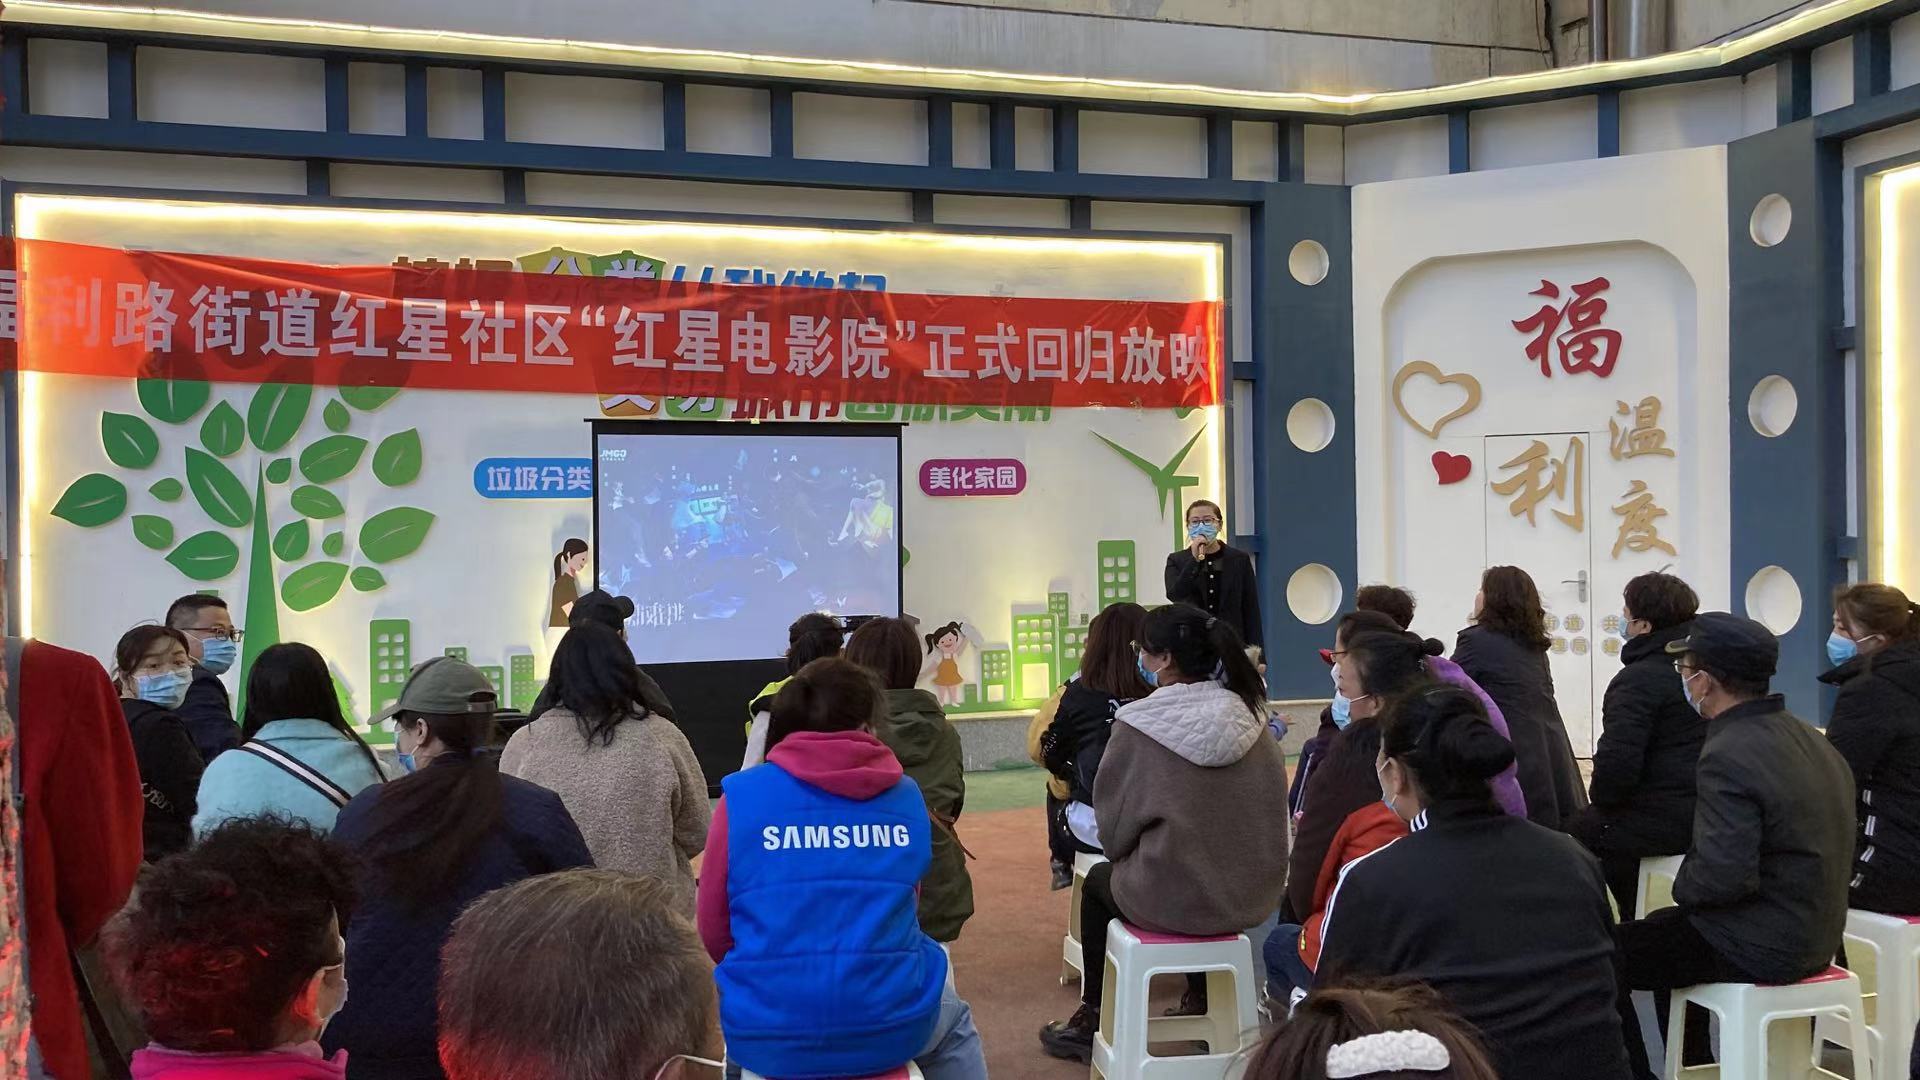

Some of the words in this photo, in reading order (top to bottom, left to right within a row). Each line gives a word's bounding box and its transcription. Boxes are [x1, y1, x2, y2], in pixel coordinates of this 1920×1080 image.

[1511, 276, 1622, 378] 福
[487, 466, 591, 491] 垃圾分类
[929, 466, 1017, 489] 美化家园
[1490, 436, 1584, 533] 利
[1608, 395, 1677, 560] 温度
[763, 825, 910, 850] SAMSUNG
